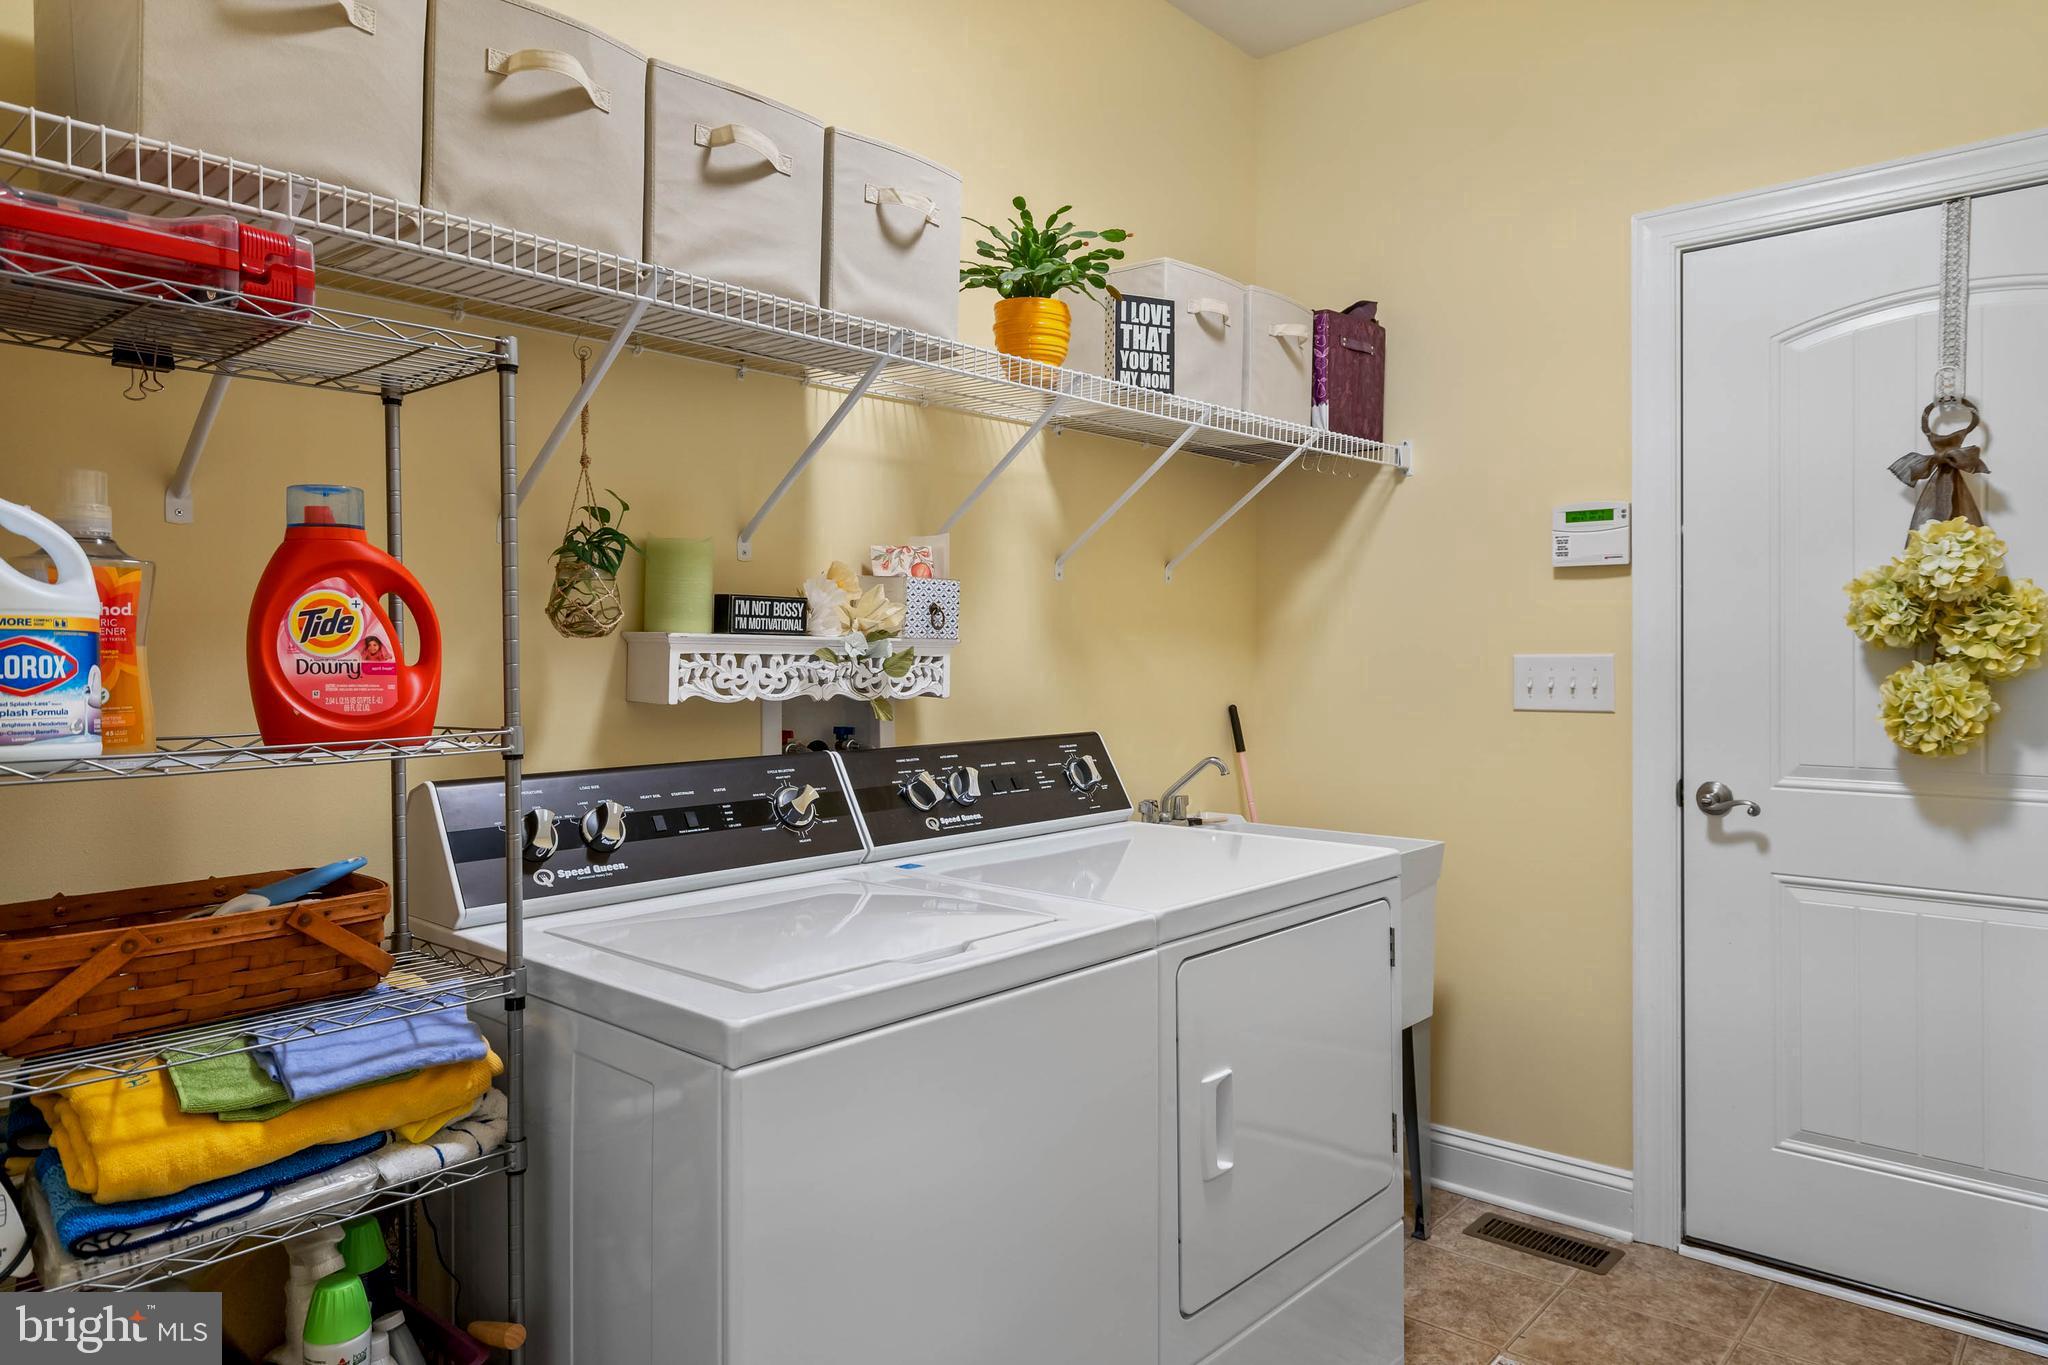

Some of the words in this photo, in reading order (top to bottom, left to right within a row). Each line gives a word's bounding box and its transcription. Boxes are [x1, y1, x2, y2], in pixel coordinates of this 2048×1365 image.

[1121, 301, 1127, 321] I
[1131, 301, 1170, 326] LOVE
[1120, 323, 1170, 352] THAT
[1120, 350, 1170, 372] YOU'RE
[1120, 370, 1138, 387] MY
[1140, 372, 1170, 389] MOM
[735, 599, 750, 615] I'M
[752, 600, 772, 616] NOT
[773, 602, 804, 617] BOSSY
[100, 627, 126, 636] ENER
[101, 619, 117, 627] RIC
[298, 608, 355, 643] Tide
[735, 617, 747, 629] I'M
[748, 617, 804, 631] MOTIVATIONAL
[296, 659, 361, 679] Downy
[31, 708, 69, 716] Formula
[939, 815, 961, 825] Speed
[557, 865, 591, 879] Speed
